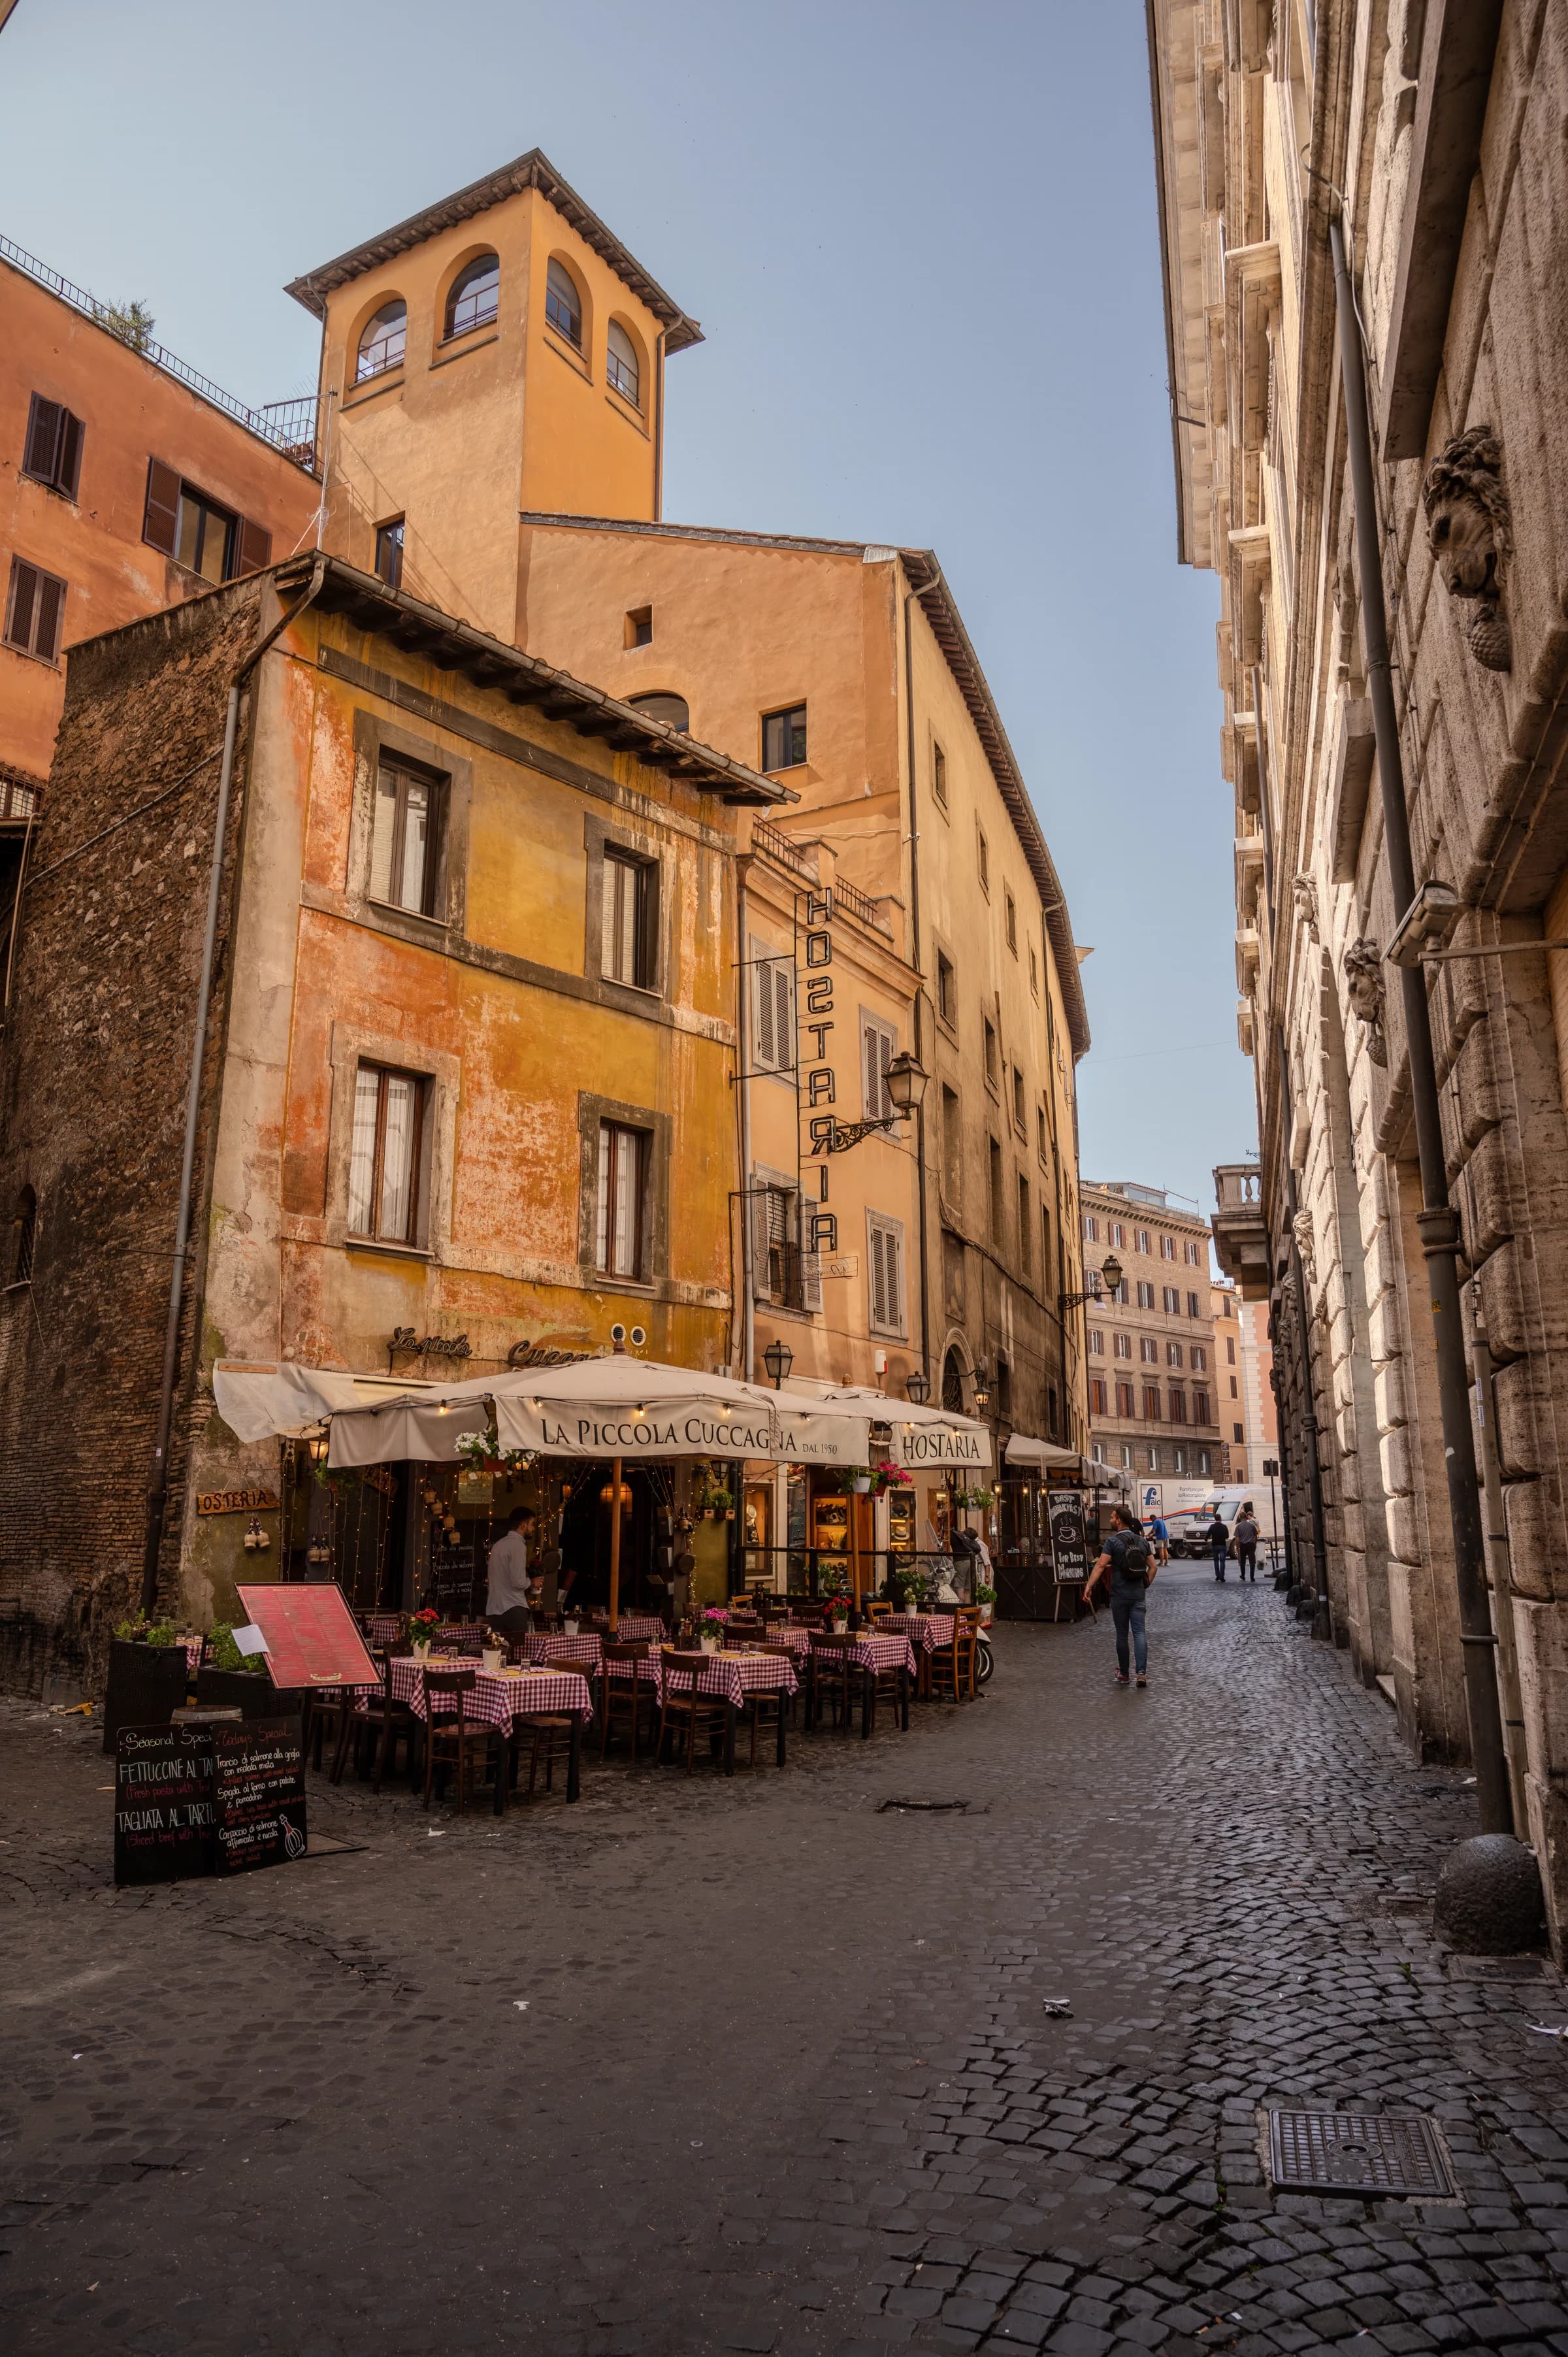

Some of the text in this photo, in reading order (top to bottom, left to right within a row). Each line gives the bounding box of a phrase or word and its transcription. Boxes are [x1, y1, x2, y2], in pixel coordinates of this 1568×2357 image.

[508, 1340, 602, 1366] Cucca
[541, 1419, 570, 1445] LA
[578, 1420, 679, 1445] PICCOLA
[802, 1443, 819, 1453] DAL
[821, 1443, 838, 1455] 1950
[902, 1434, 981, 1460] HOSTARIA
[203, 1489, 269, 1510] OSTERIA
[1054, 1494, 1075, 1504] BEST
[125, 1732, 174, 1750] Seasonal
[215, 1755, 238, 1769] Trancio
[242, 1753, 248, 1765] di
[250, 1750, 272, 1762] salmone
[285, 1748, 300, 1762] griglia
[120, 1758, 184, 1783] FETTUCCINE
[186, 1759, 197, 1779] AL
[224, 1768, 235, 1777] con
[177, 1781, 194, 1794] with
[217, 1775, 297, 1800] Spigola al forno con patate
[116, 1808, 165, 1833] TAGLIATA
[169, 1808, 186, 1828] AL
[219, 1827, 247, 1841] Carpaccio
[255, 1820, 278, 1830] salmone
[177, 1826, 194, 1841] with
